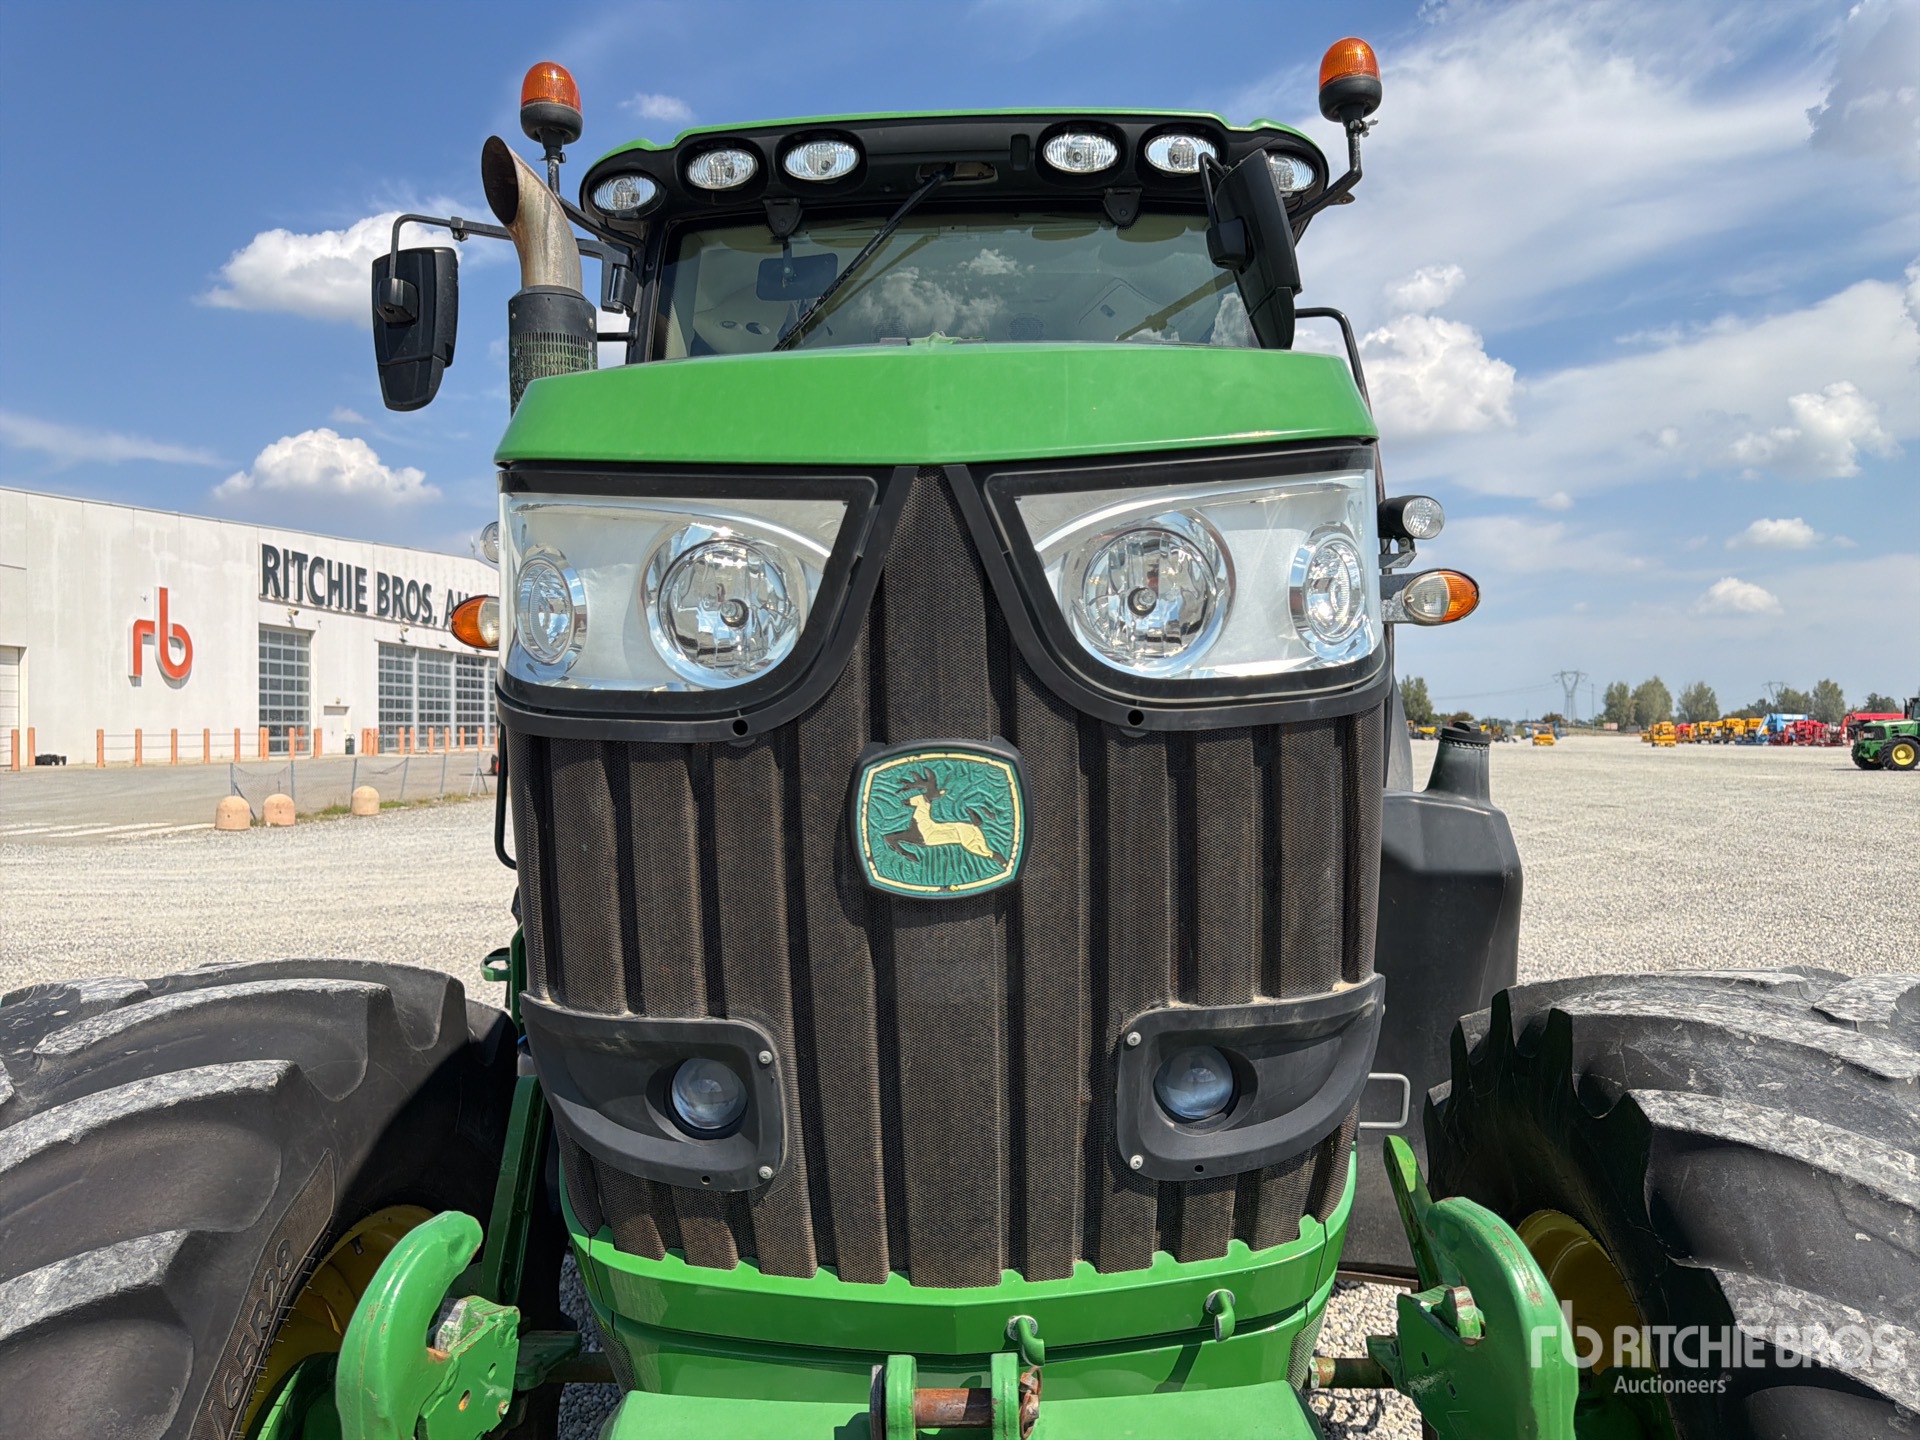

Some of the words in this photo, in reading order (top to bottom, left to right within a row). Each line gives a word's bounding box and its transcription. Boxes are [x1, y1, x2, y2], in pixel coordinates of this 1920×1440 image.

[261, 543, 368, 613] RITCHIE
[377, 571, 437, 625] BROS.
[132, 587, 193, 680] rb
